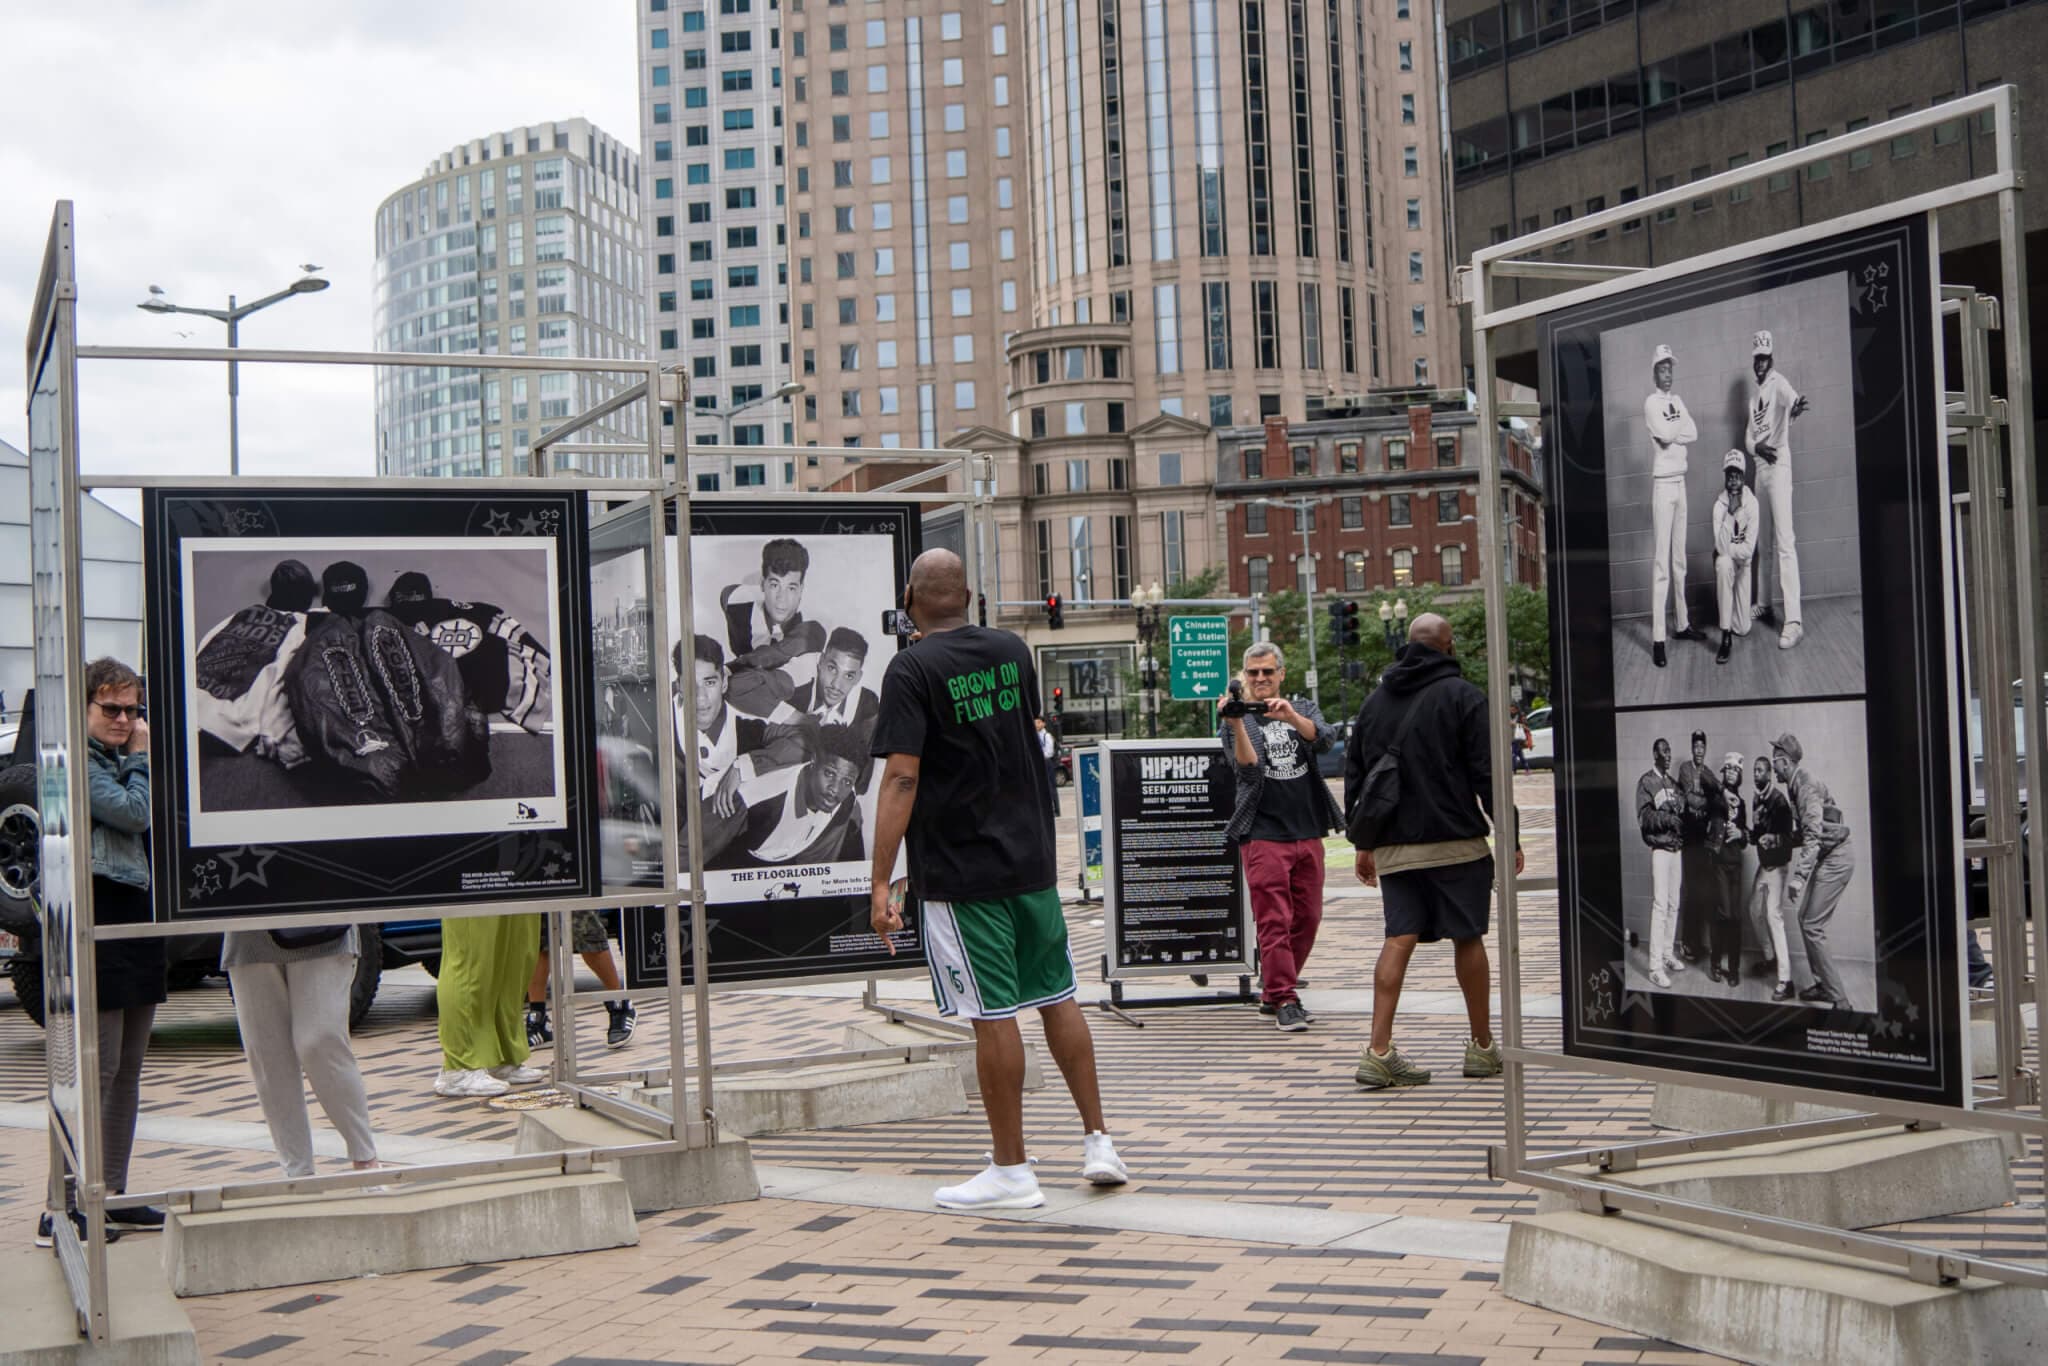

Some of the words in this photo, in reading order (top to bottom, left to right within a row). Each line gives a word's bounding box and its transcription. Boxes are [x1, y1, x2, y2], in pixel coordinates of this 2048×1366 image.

[1185, 621, 1226, 629] Chinatown
[1198, 633, 1225, 641] Station
[1177, 649, 1222, 657] Convention
[1187, 659, 1213, 667] Center
[1193, 671, 1220, 679] Boston
[948, 667, 996, 700] GROW
[1000, 661, 1019, 686] ON
[954, 694, 994, 724] FLOW
[1142, 784, 1209, 795] SEEN/UNSEEN
[732, 872, 754, 882] THE
[757, 866, 831, 880] FLOORLORDS
